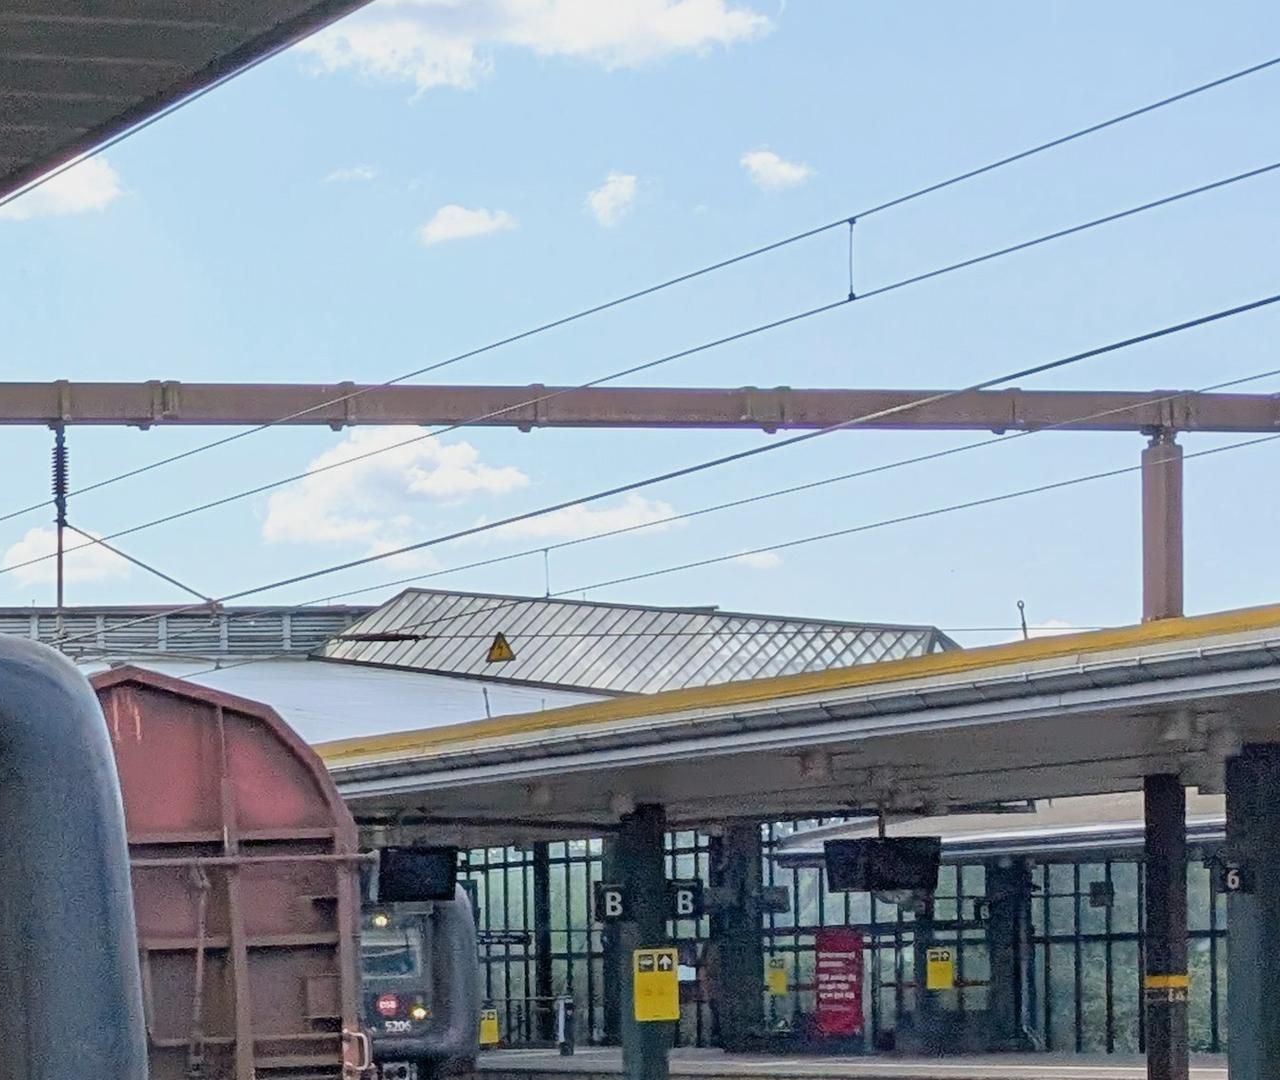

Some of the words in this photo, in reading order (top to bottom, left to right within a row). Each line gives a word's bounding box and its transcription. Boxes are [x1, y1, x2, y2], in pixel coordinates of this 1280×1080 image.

[1227, 869, 1240, 890] 6
[605, 891, 624, 916] B
[677, 890, 694, 915] B
